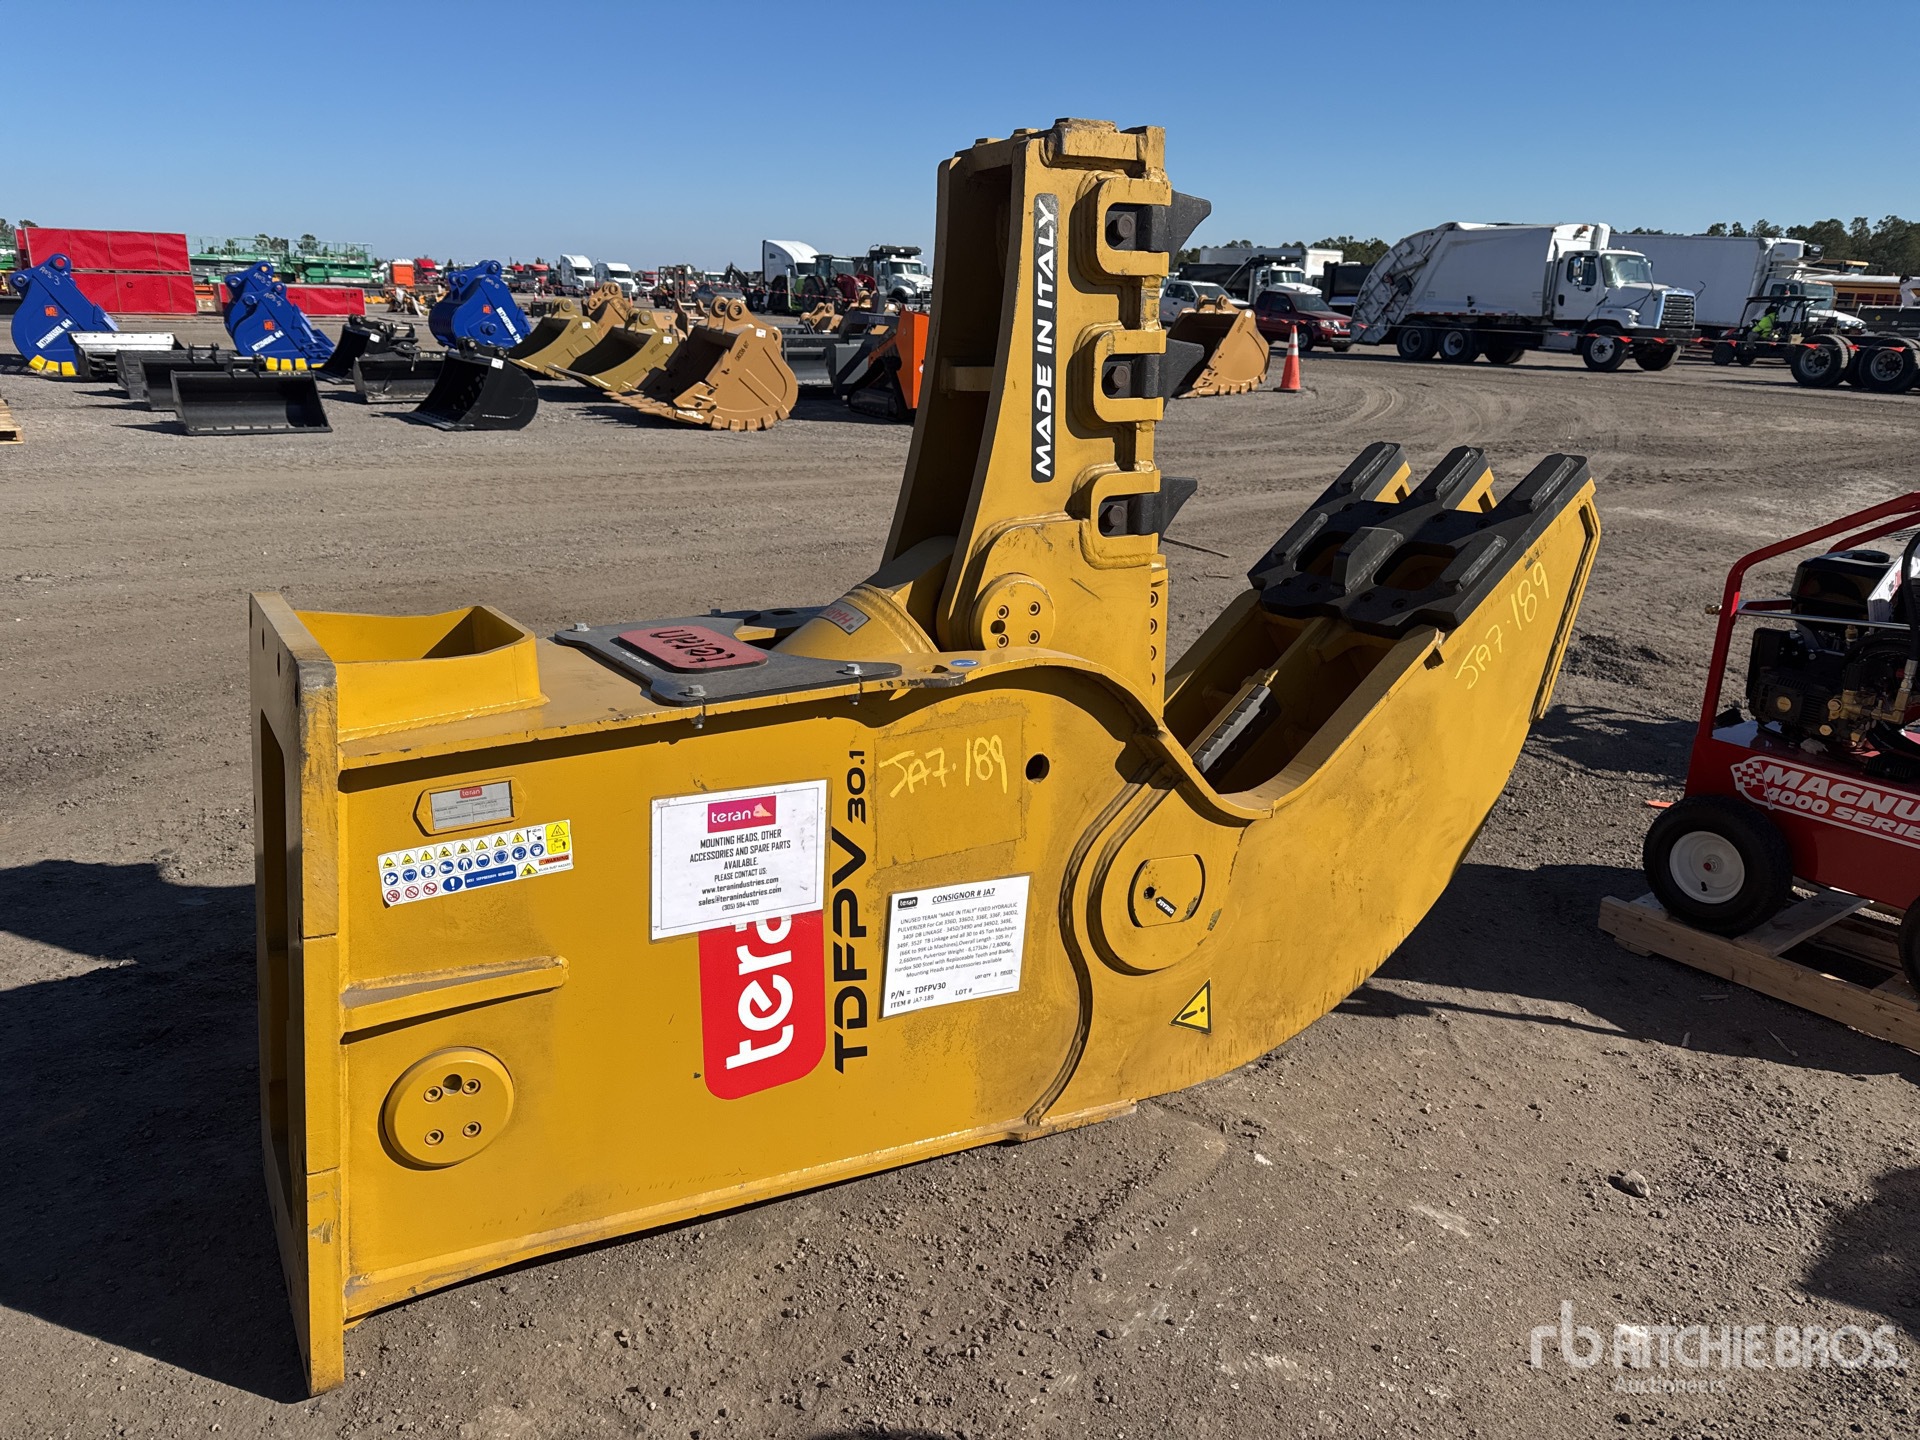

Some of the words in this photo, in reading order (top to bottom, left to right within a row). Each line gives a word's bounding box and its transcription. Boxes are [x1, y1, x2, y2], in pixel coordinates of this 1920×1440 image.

[1037, 198, 1056, 310] ITALY
[1037, 319, 1053, 354] IN
[1035, 364, 1054, 477] MADE
[649, 630, 736, 664] teran
[462, 788, 480, 796] teran
[847, 750, 866, 824] 30.1
[1762, 764, 1920, 822] MAGNU
[1764, 788, 1830, 814] 4000
[711, 809, 751, 824] teran
[700, 835, 735, 848] MOUNTING
[736, 833, 760, 844] HEADS,
[761, 828, 782, 842] OTHER
[690, 846, 734, 863] ACCESSORIES
[735, 846, 748, 856] AND
[750, 842, 770, 855] SPARE
[772, 840, 791, 851] PARTS
[724, 858, 758, 870] AVAILABLE.
[714, 872, 734, 882] PLEASE
[734, 869, 758, 880] CONTACT
[759, 868, 768, 876] US:
[702, 876, 779, 894] www.teranindustries.com
[698, 886, 782, 906] sales@teranindustries.com
[899, 898, 917, 906] teran
[932, 890, 975, 904] CONSIGNOR
[976, 889, 982, 897] #
[983, 888, 996, 896] JA7
[722, 902, 736, 912] (305)
[900, 916, 922, 924] UNUSED
[992, 902, 1018, 910] HYDRAULIC
[1156, 898, 1175, 915] GREASE
[898, 923, 926, 934] PULVERIZER
[923, 929, 943, 937] LINKAGE
[932, 935, 949, 943] Linkage
[832, 826, 869, 1074] TDFPV
[946, 954, 974, 963] Replaceable
[906, 969, 929, 977] Mounting
[955, 960, 981, 969] Accessories
[982, 957, 1002, 965] available
[891, 990, 905, 1000] P/N
[914, 982, 946, 994] TDFPV30
[890, 1000, 906, 1009] ITEM
[913, 995, 934, 1004] JA7-189
